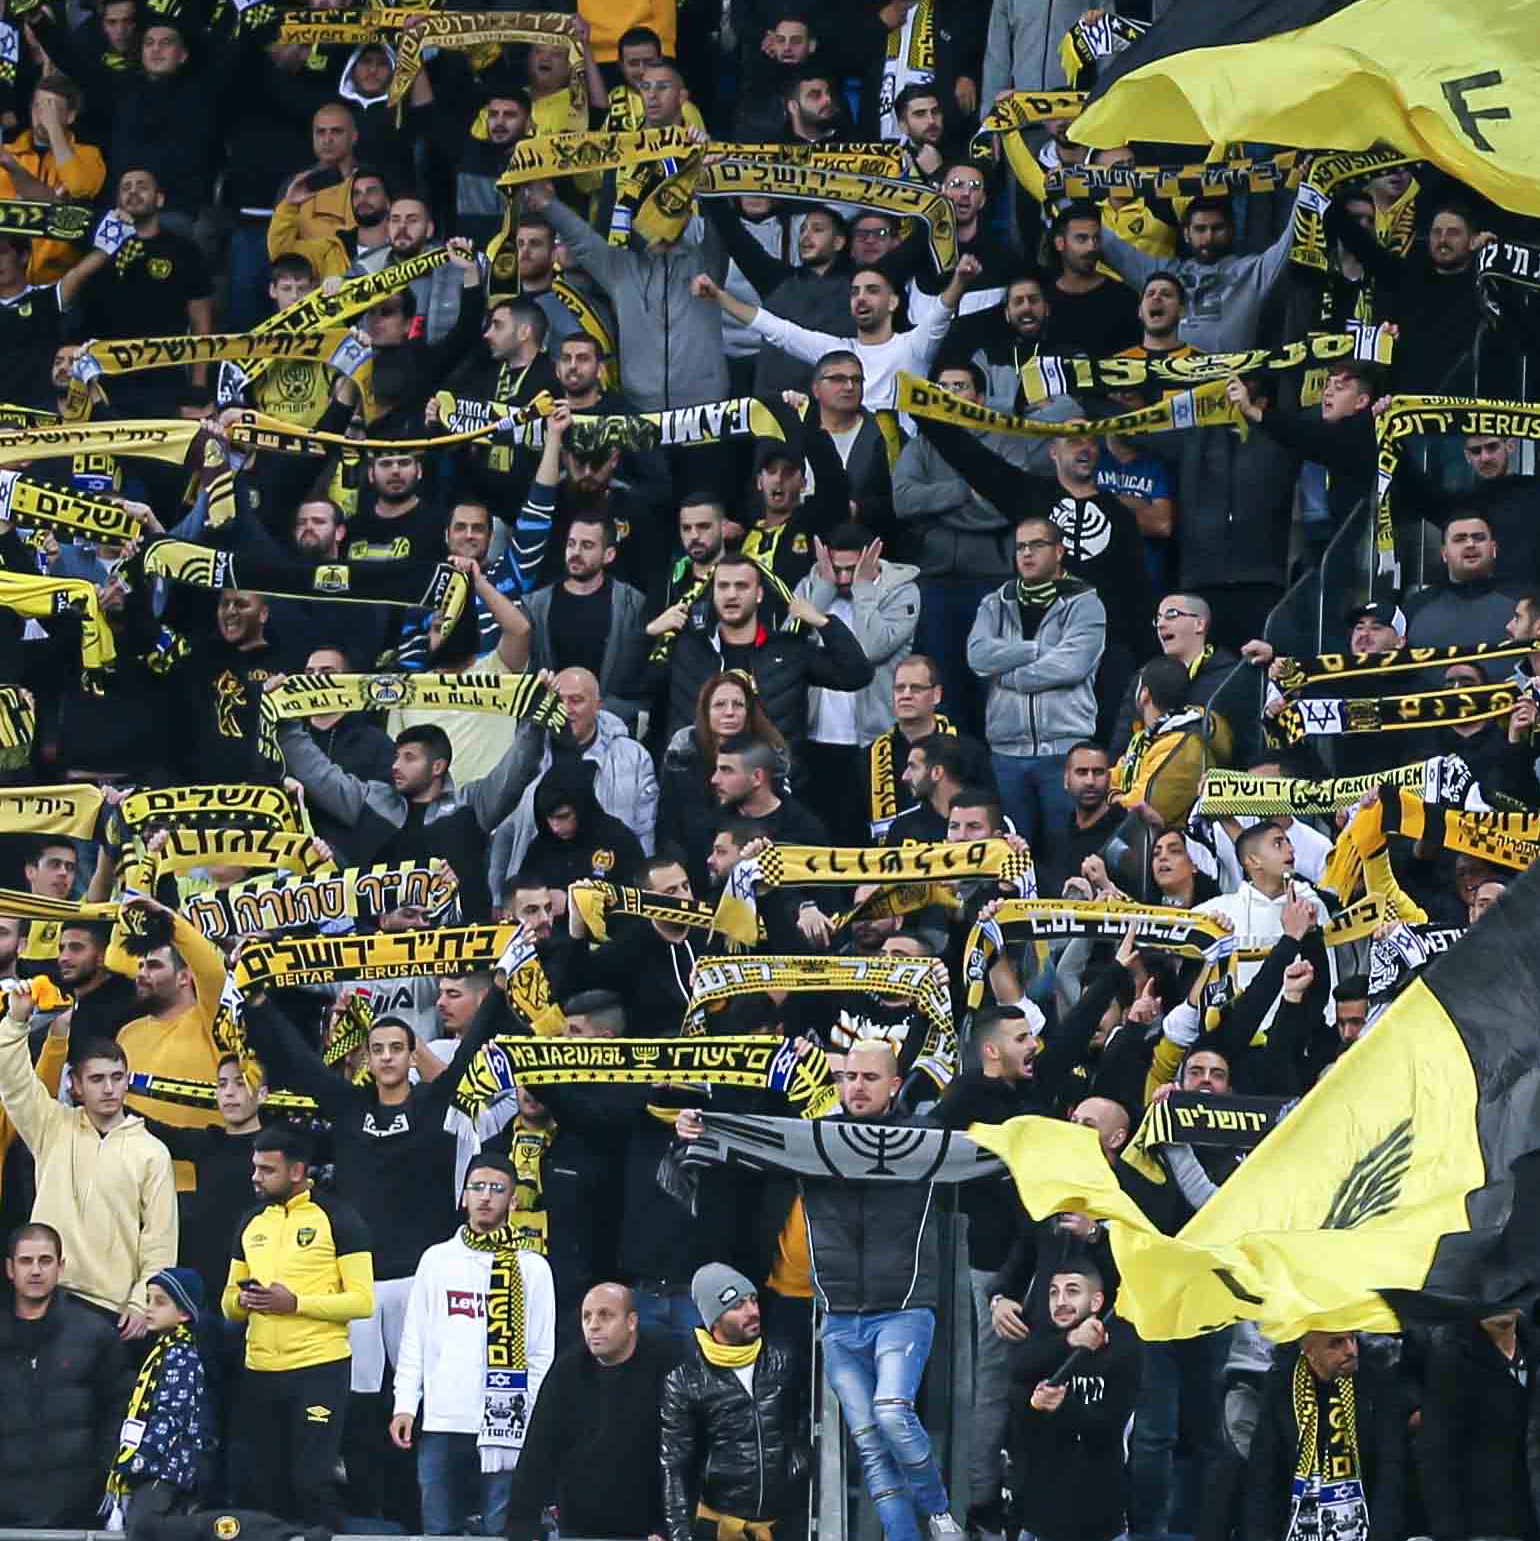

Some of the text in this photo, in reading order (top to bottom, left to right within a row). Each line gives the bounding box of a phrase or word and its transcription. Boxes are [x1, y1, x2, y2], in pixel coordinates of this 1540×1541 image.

[109, 338, 229, 369] ירושלים
[37, 495, 130, 533] ושלים
[1207, 780, 1289, 799] ירושלים
[242, 939, 377, 979] ירושלים
[276, 962, 459, 986] BEITAR JERUSALEM
[1174, 1103, 1268, 1131] ירושלים
